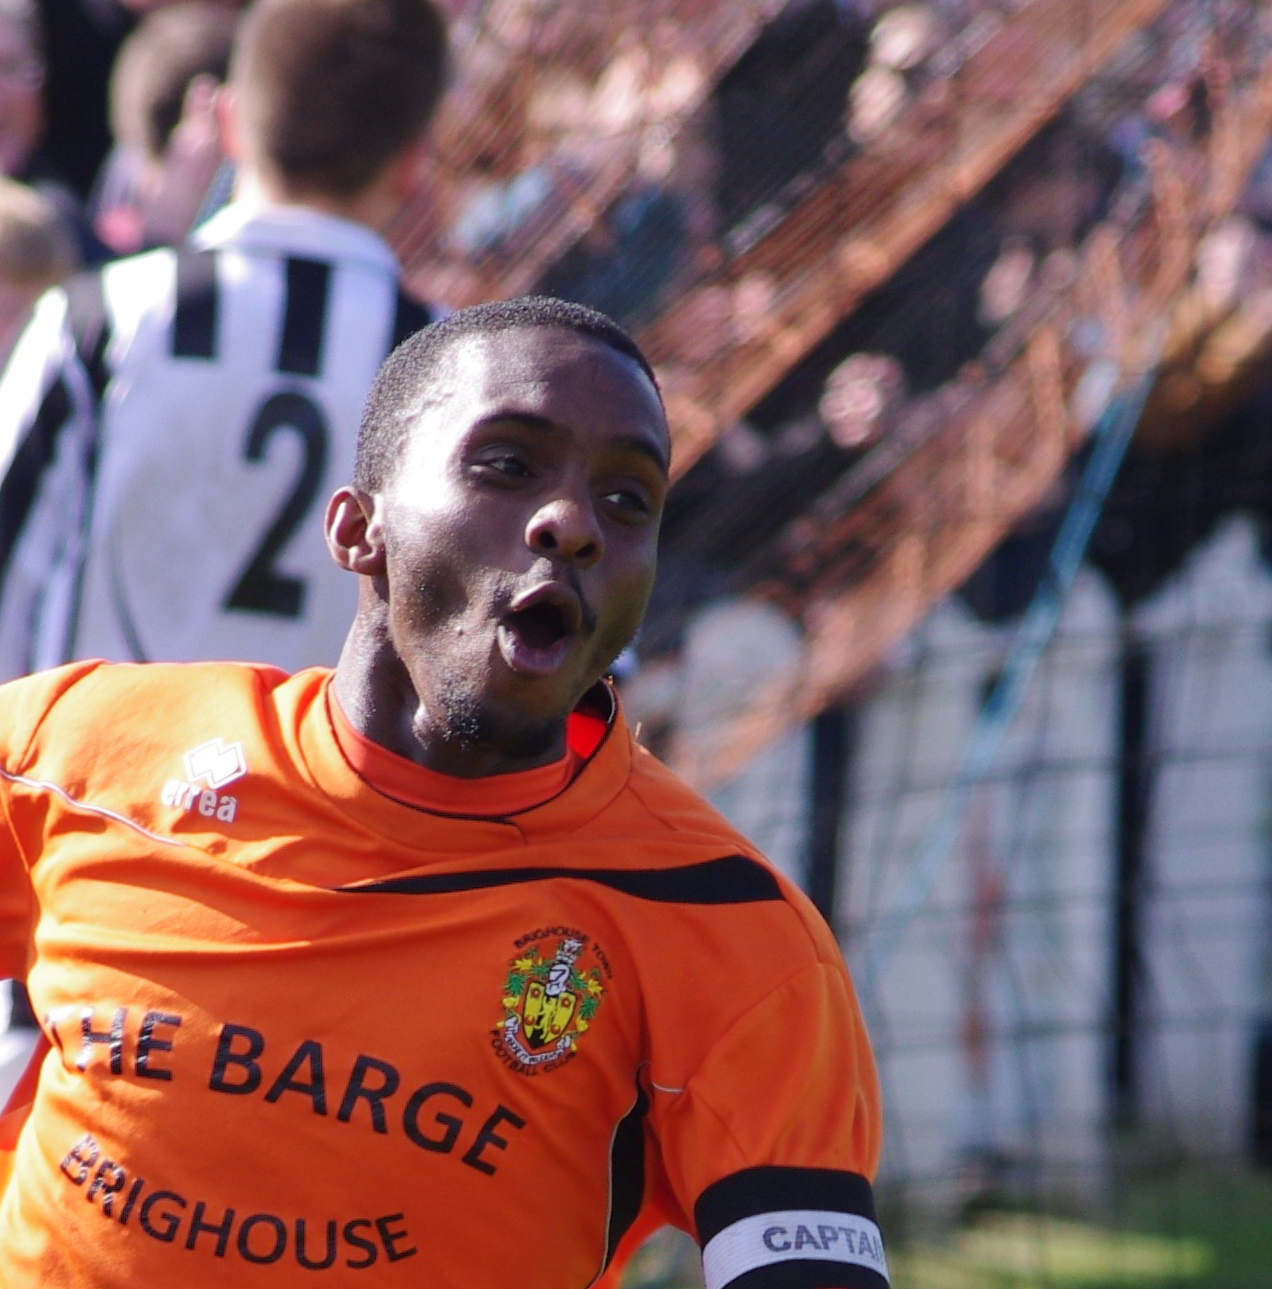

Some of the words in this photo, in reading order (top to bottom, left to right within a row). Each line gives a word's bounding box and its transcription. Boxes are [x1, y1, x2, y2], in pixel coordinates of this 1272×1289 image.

[223, 390, 328, 617] 2
[514, 926, 591, 948] BRIGHOUSE
[591, 943, 613, 979] TOWN
[45, 1006, 182, 1080] THE
[208, 1023, 525, 1176] BARGE
[490, 1029, 538, 1076] FOOTBALL
[58, 1135, 418, 1272] BRIGHOUSE
